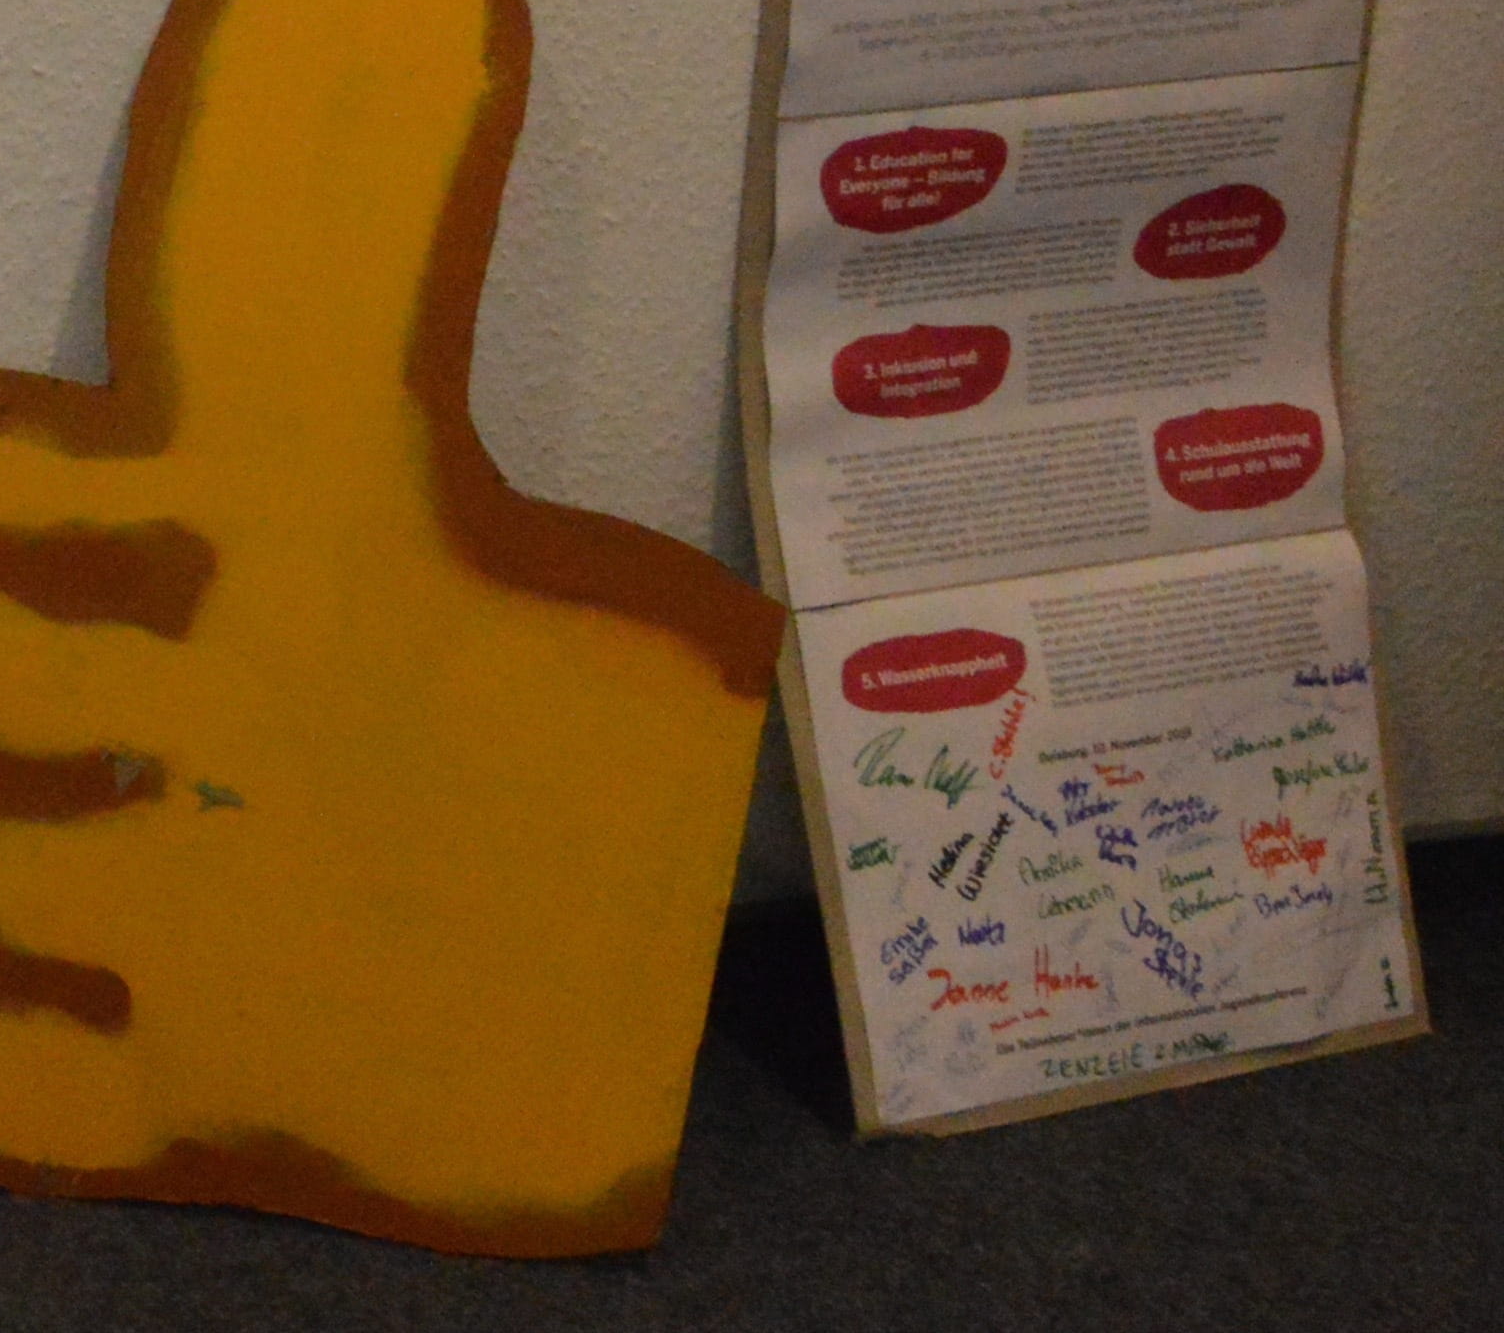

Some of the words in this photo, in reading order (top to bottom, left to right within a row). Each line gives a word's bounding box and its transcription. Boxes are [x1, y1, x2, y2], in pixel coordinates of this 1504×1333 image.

[869, 150, 948, 171] Education
[950, 147, 975, 162] for
[839, 175, 909, 195] Everyone
